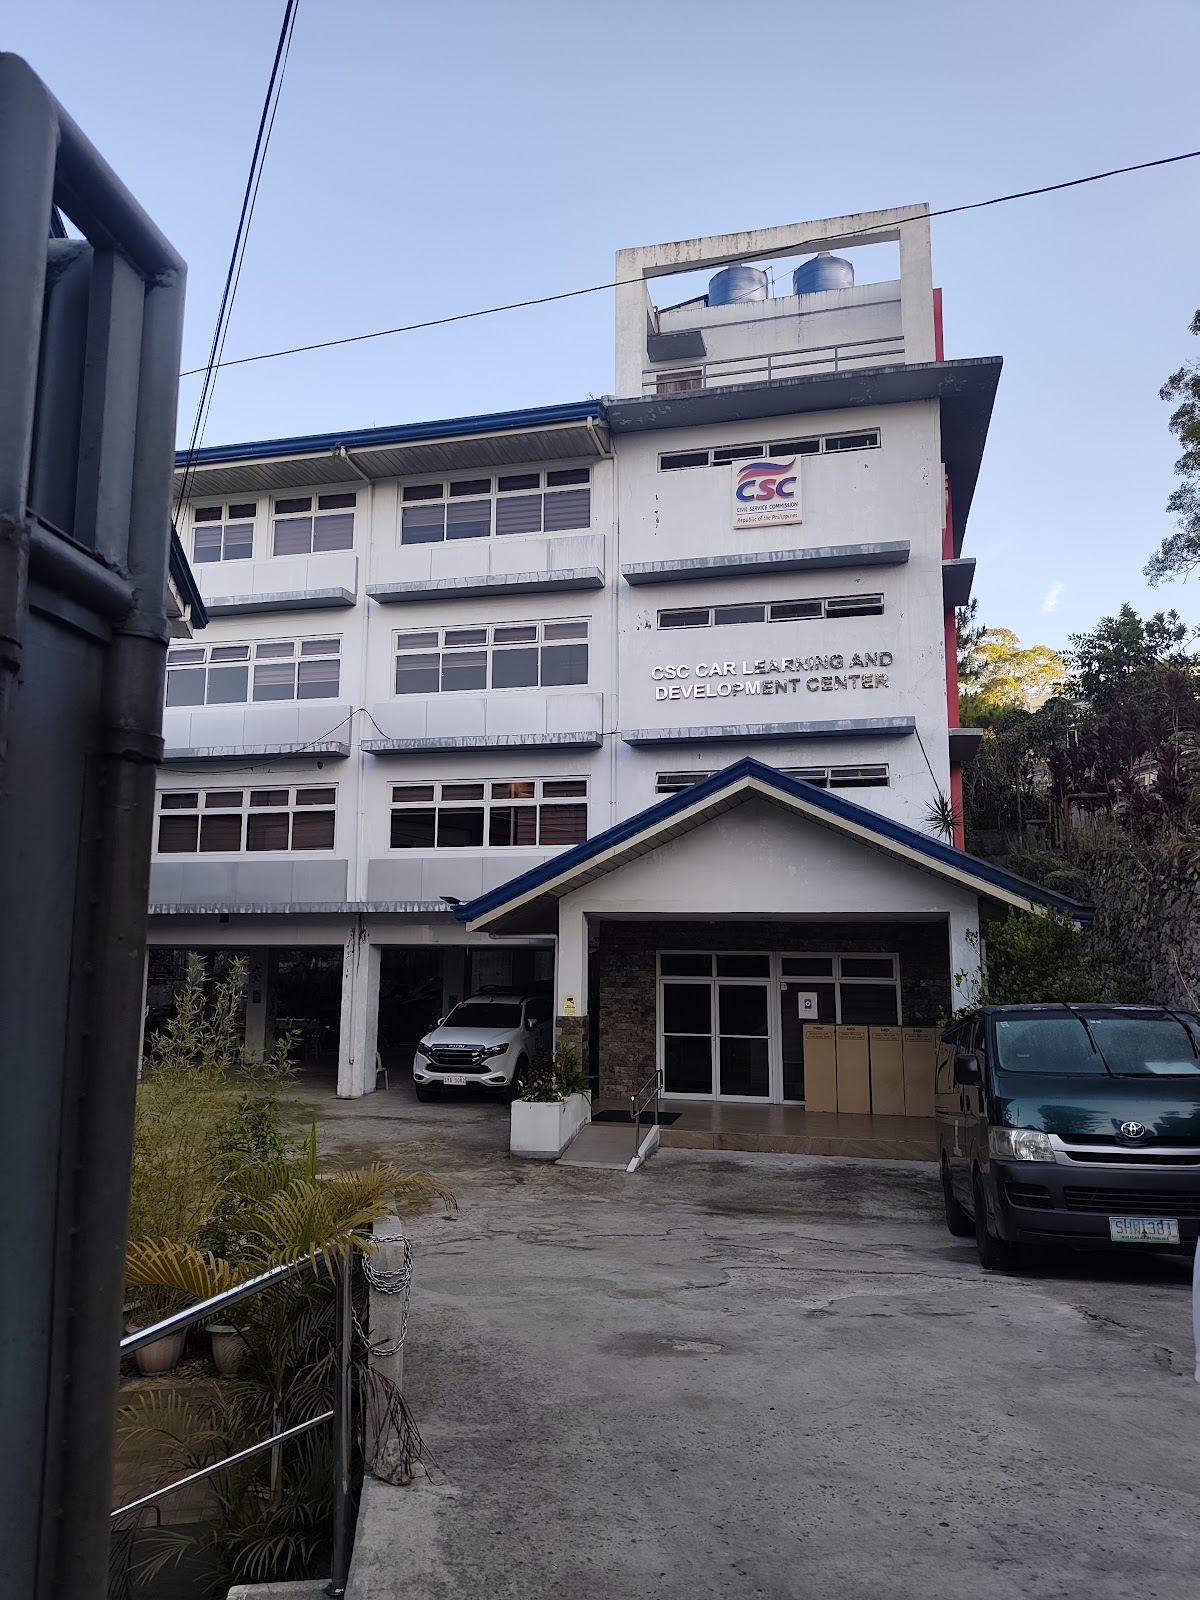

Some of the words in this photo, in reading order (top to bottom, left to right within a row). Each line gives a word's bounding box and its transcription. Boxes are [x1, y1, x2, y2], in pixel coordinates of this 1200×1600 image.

[736, 477, 797, 502] CSC
[769, 501, 799, 510] COMMISSION
[651, 664, 690, 681] CSC
[695, 662, 737, 678] CAR
[742, 654, 844, 676] LEARNING
[849, 651, 894, 669] AND
[655, 678, 802, 701] DEVELOPMENT
[806, 673, 890, 692] CENTER
